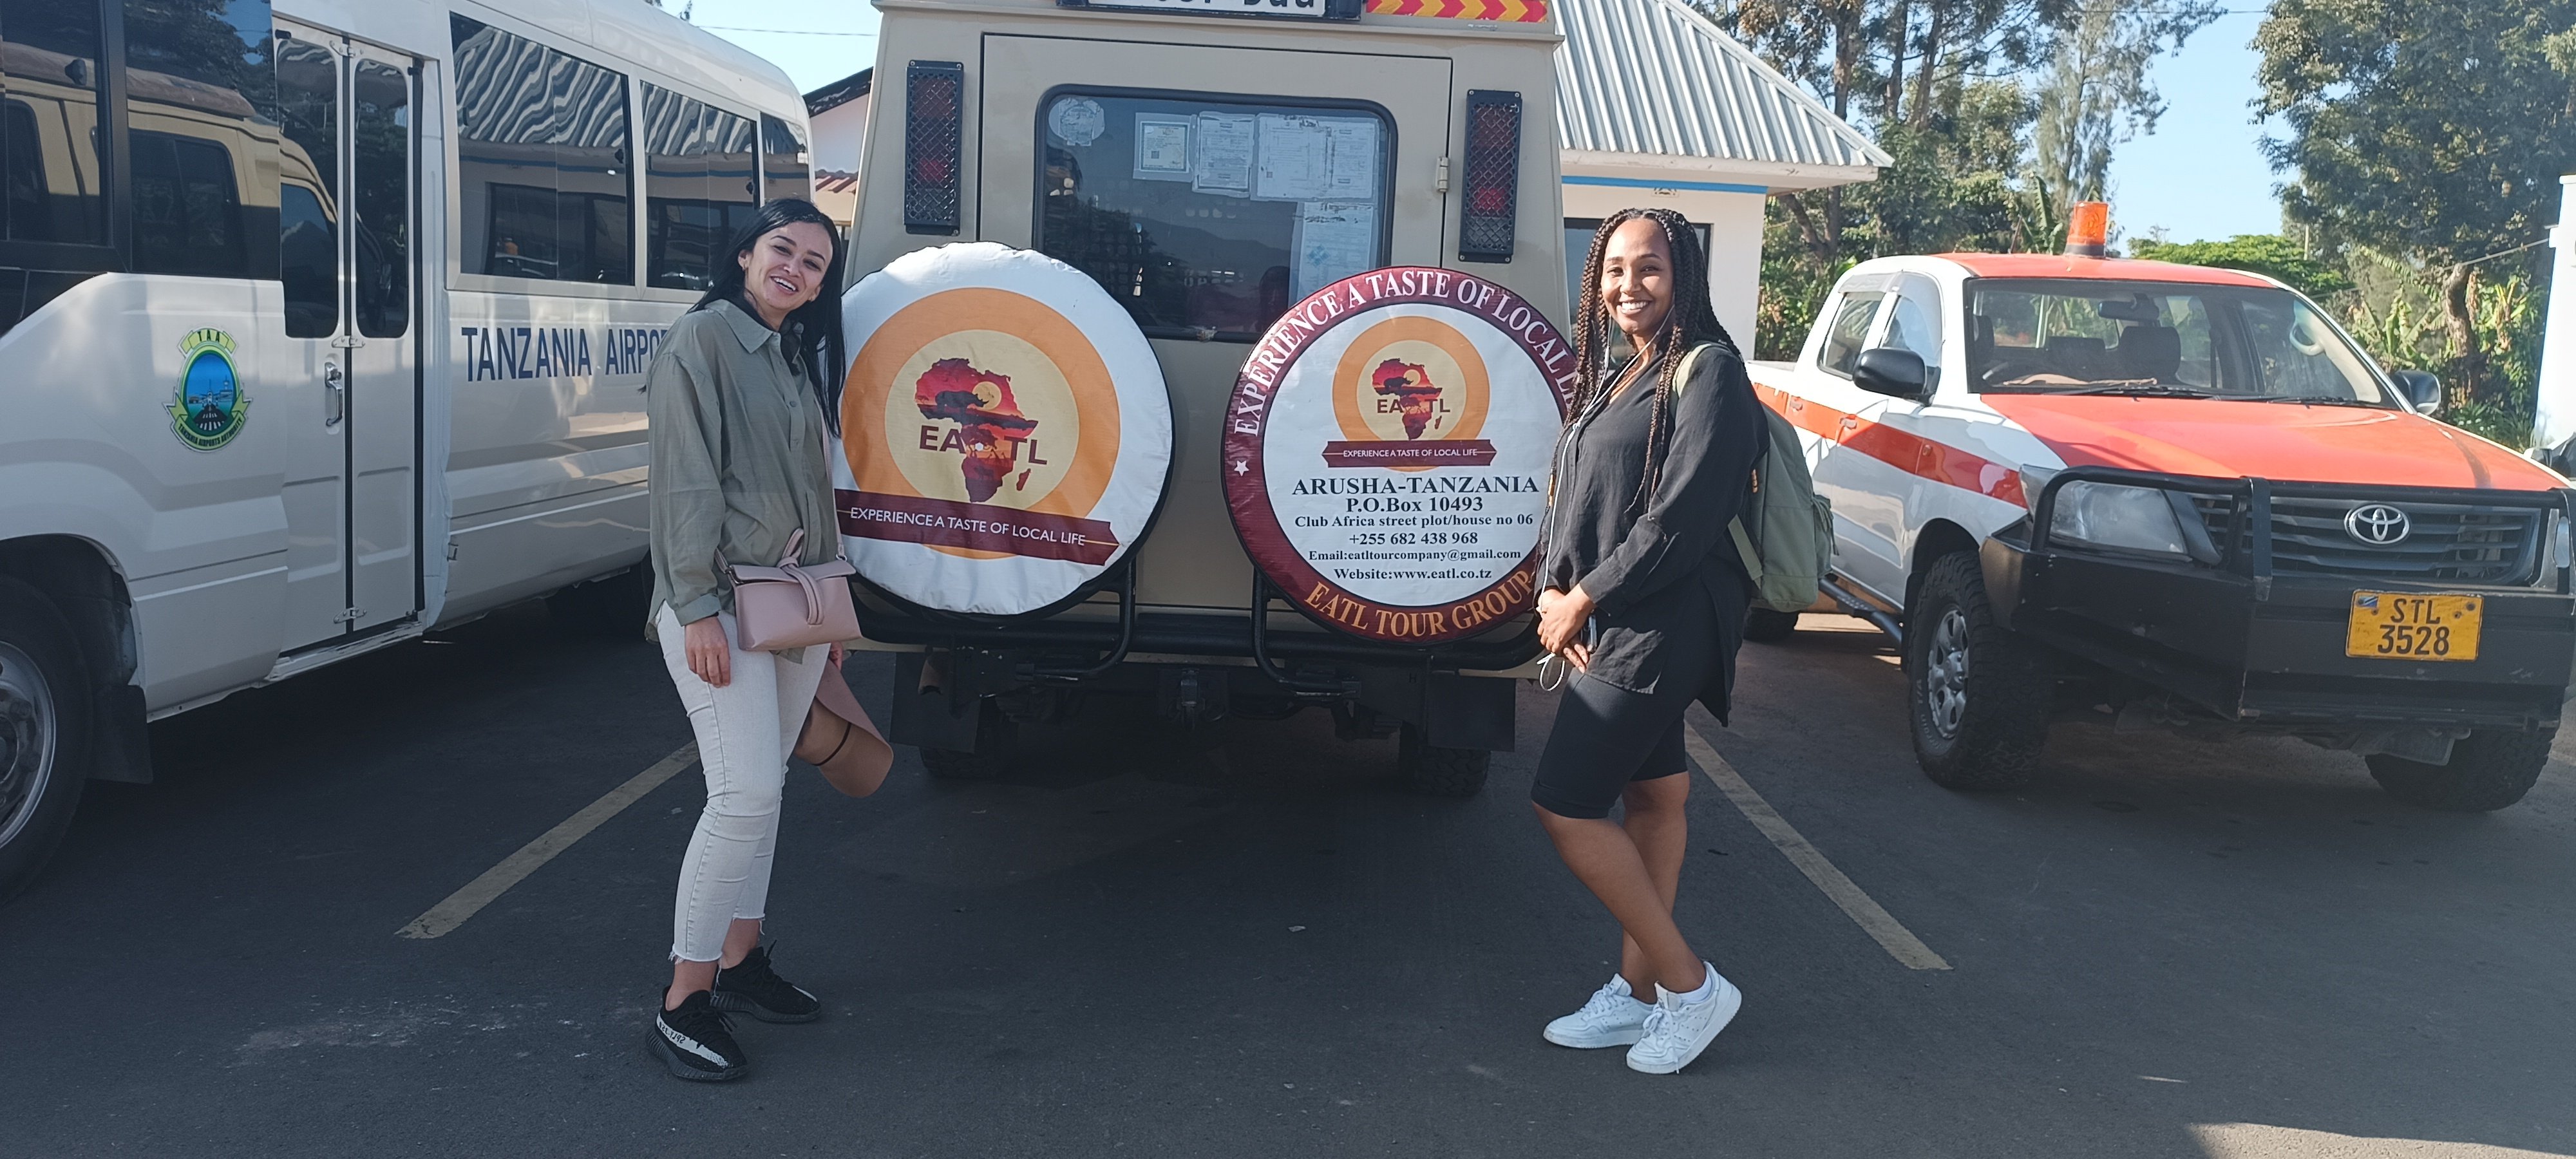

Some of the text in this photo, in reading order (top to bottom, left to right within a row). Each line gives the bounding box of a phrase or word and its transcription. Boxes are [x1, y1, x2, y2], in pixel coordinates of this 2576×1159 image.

[197, 329, 220, 343] TAA
[461, 327, 668, 382] TANZANIA AIRPO
[1234, 270, 1568, 437] EXPERIENCE A TASTE OF LOCAL
[1343, 449, 1390, 458] EXPERIENCE
[1292, 476, 1540, 495] ARUSHA-TANZANIA
[1345, 496, 1484, 513] P.O.Box 10493
[851, 507, 1086, 546] EXPERIENCE A TASTE OF LOCAL LIFE
[1294, 513, 1533, 529] Club Africa street plot/house no 06
[1349, 532, 1479, 545] +255 682 438 968
[1309, 549, 1521, 562] Email:eatltourcompany@gmail.com
[1334, 567, 1492, 580] Website:www.eatl.co.tz
[1304, 570, 1534, 637] EATL TOUR GROUP
[2390, 598, 2441, 625] STL
[2378, 624, 2450, 655] 3528
